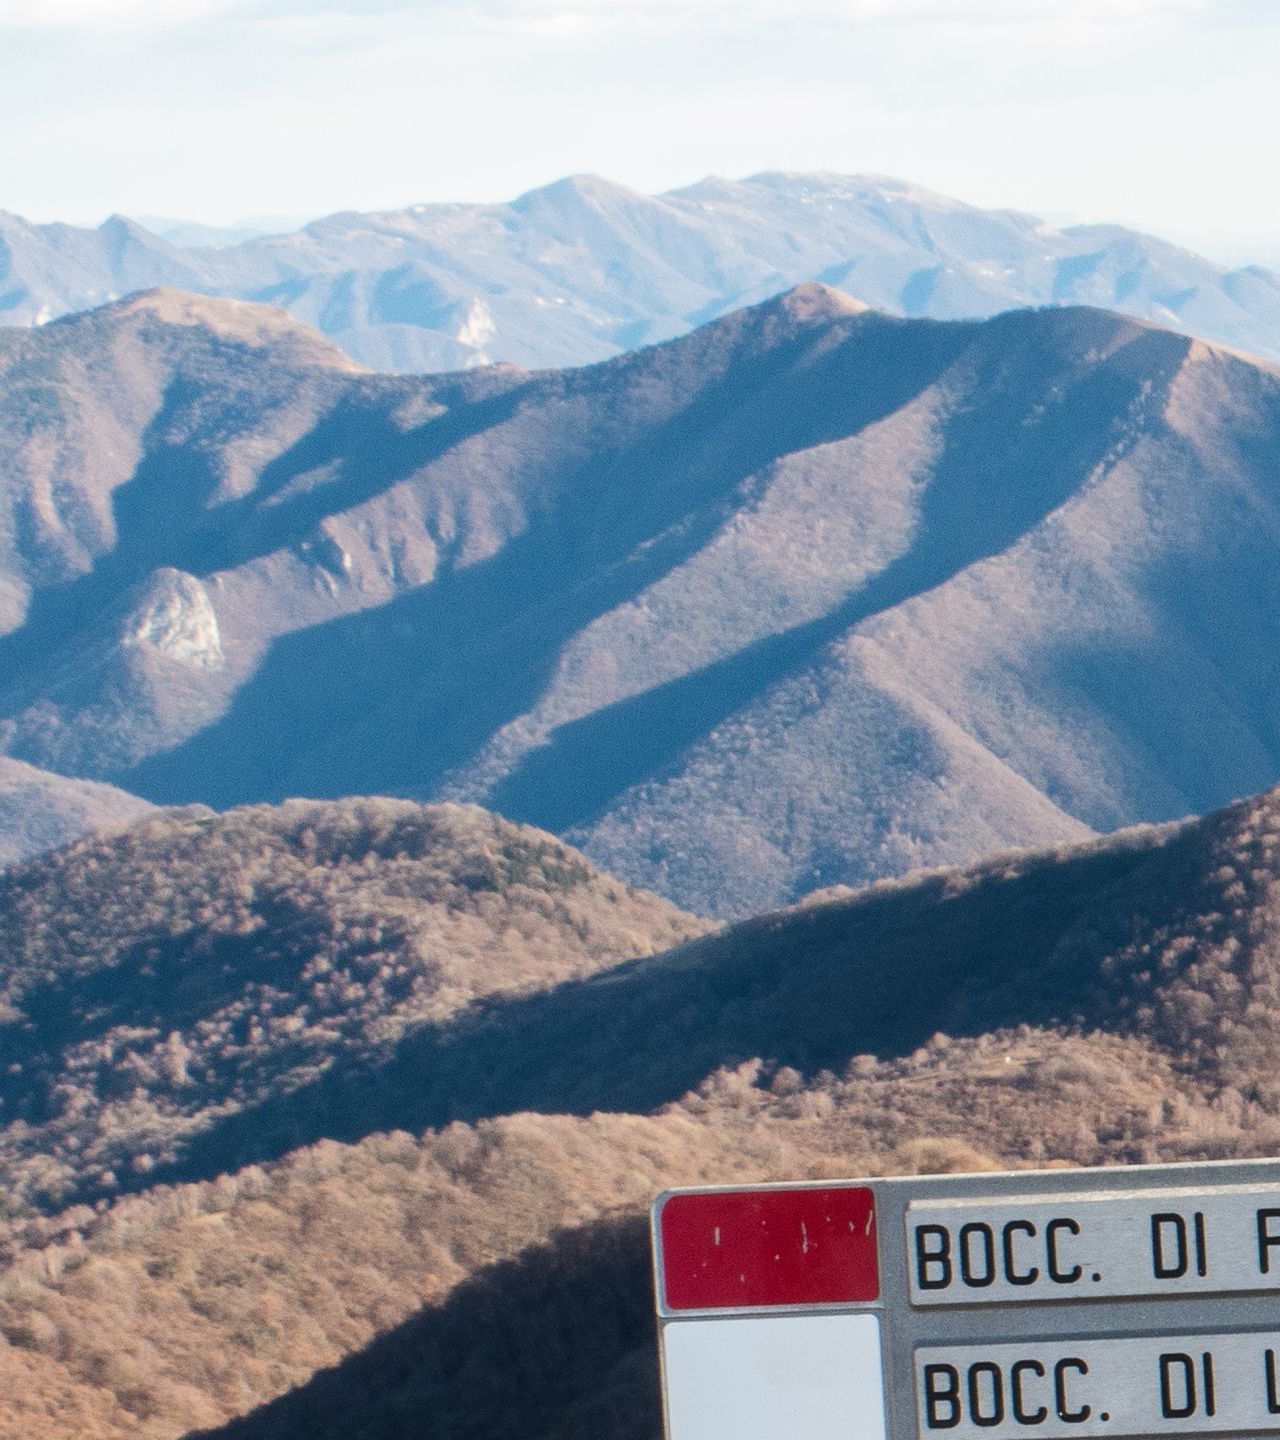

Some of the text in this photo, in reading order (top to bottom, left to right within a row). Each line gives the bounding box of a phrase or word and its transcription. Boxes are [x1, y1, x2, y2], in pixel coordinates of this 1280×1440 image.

[915, 1217, 1102, 1291] BOCC.
[1150, 1211, 1207, 1280] DI
[924, 1357, 1111, 1430] BOCC.
[1158, 1351, 1215, 1419] DI
